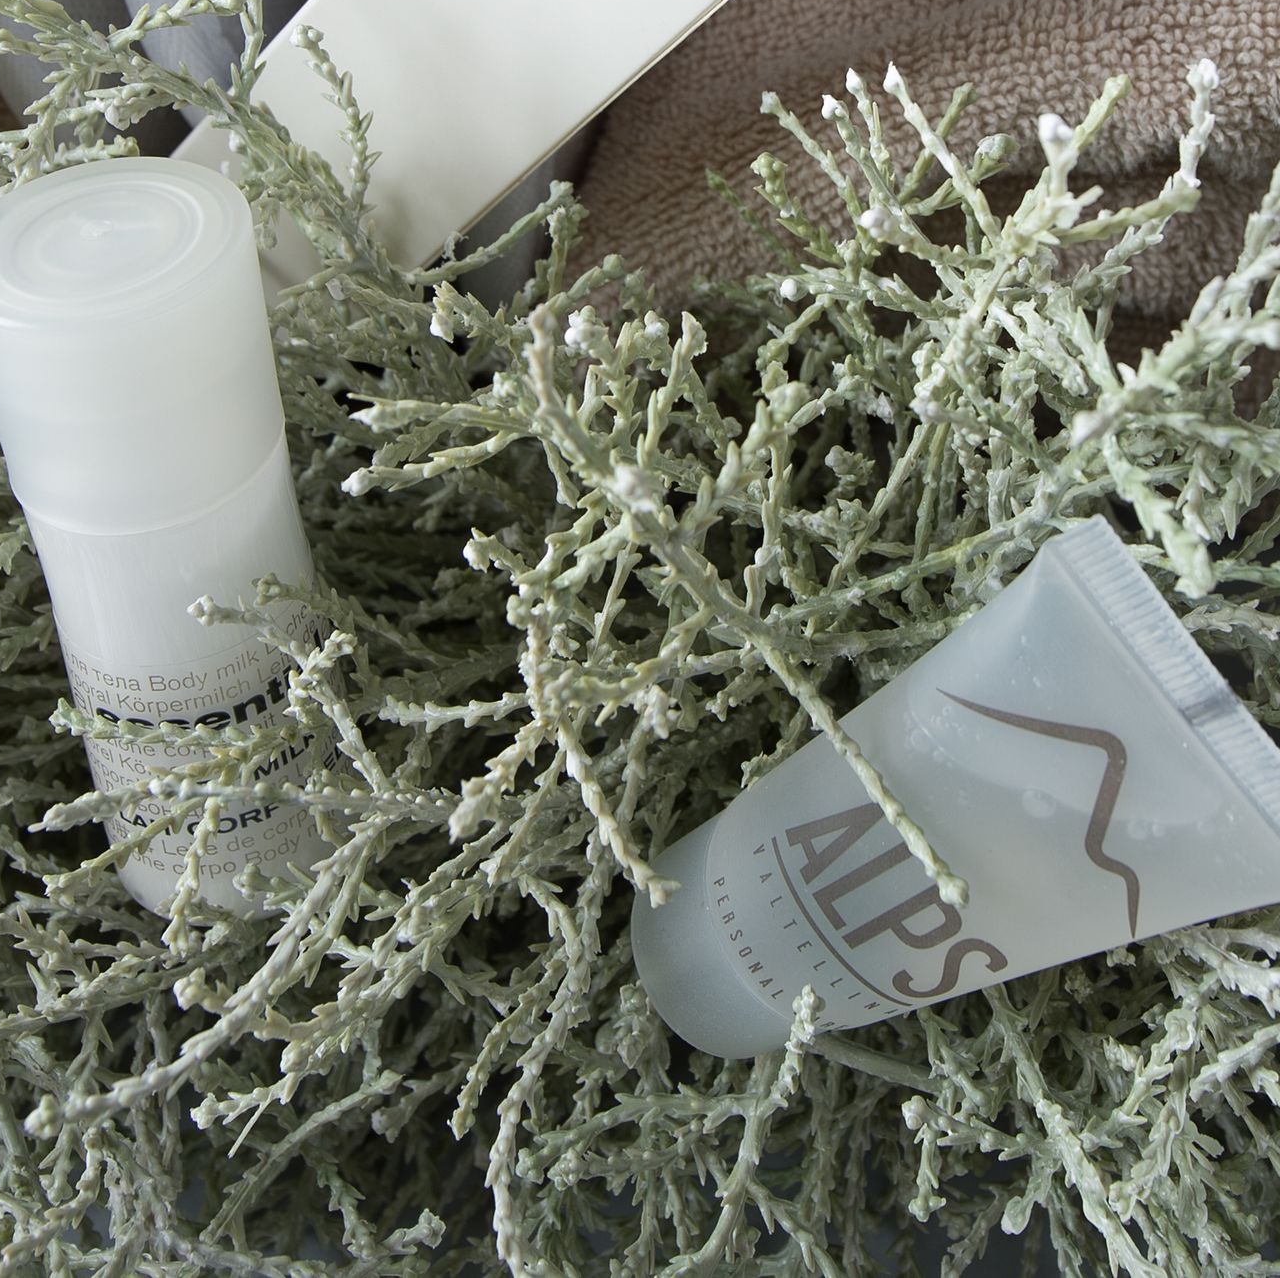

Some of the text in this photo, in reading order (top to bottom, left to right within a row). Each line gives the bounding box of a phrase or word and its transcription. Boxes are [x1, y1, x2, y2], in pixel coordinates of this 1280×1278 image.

[92, 668, 142, 692] тела
[148, 671, 208, 692] Body
[216, 648, 260, 681] milk
[117, 678, 251, 718] Körpermilch
[227, 836, 255, 852] de
[172, 861, 237, 880] crpo
[784, 802, 1009, 999] ALPS
[713, 876, 784, 1000] PERSONAL
